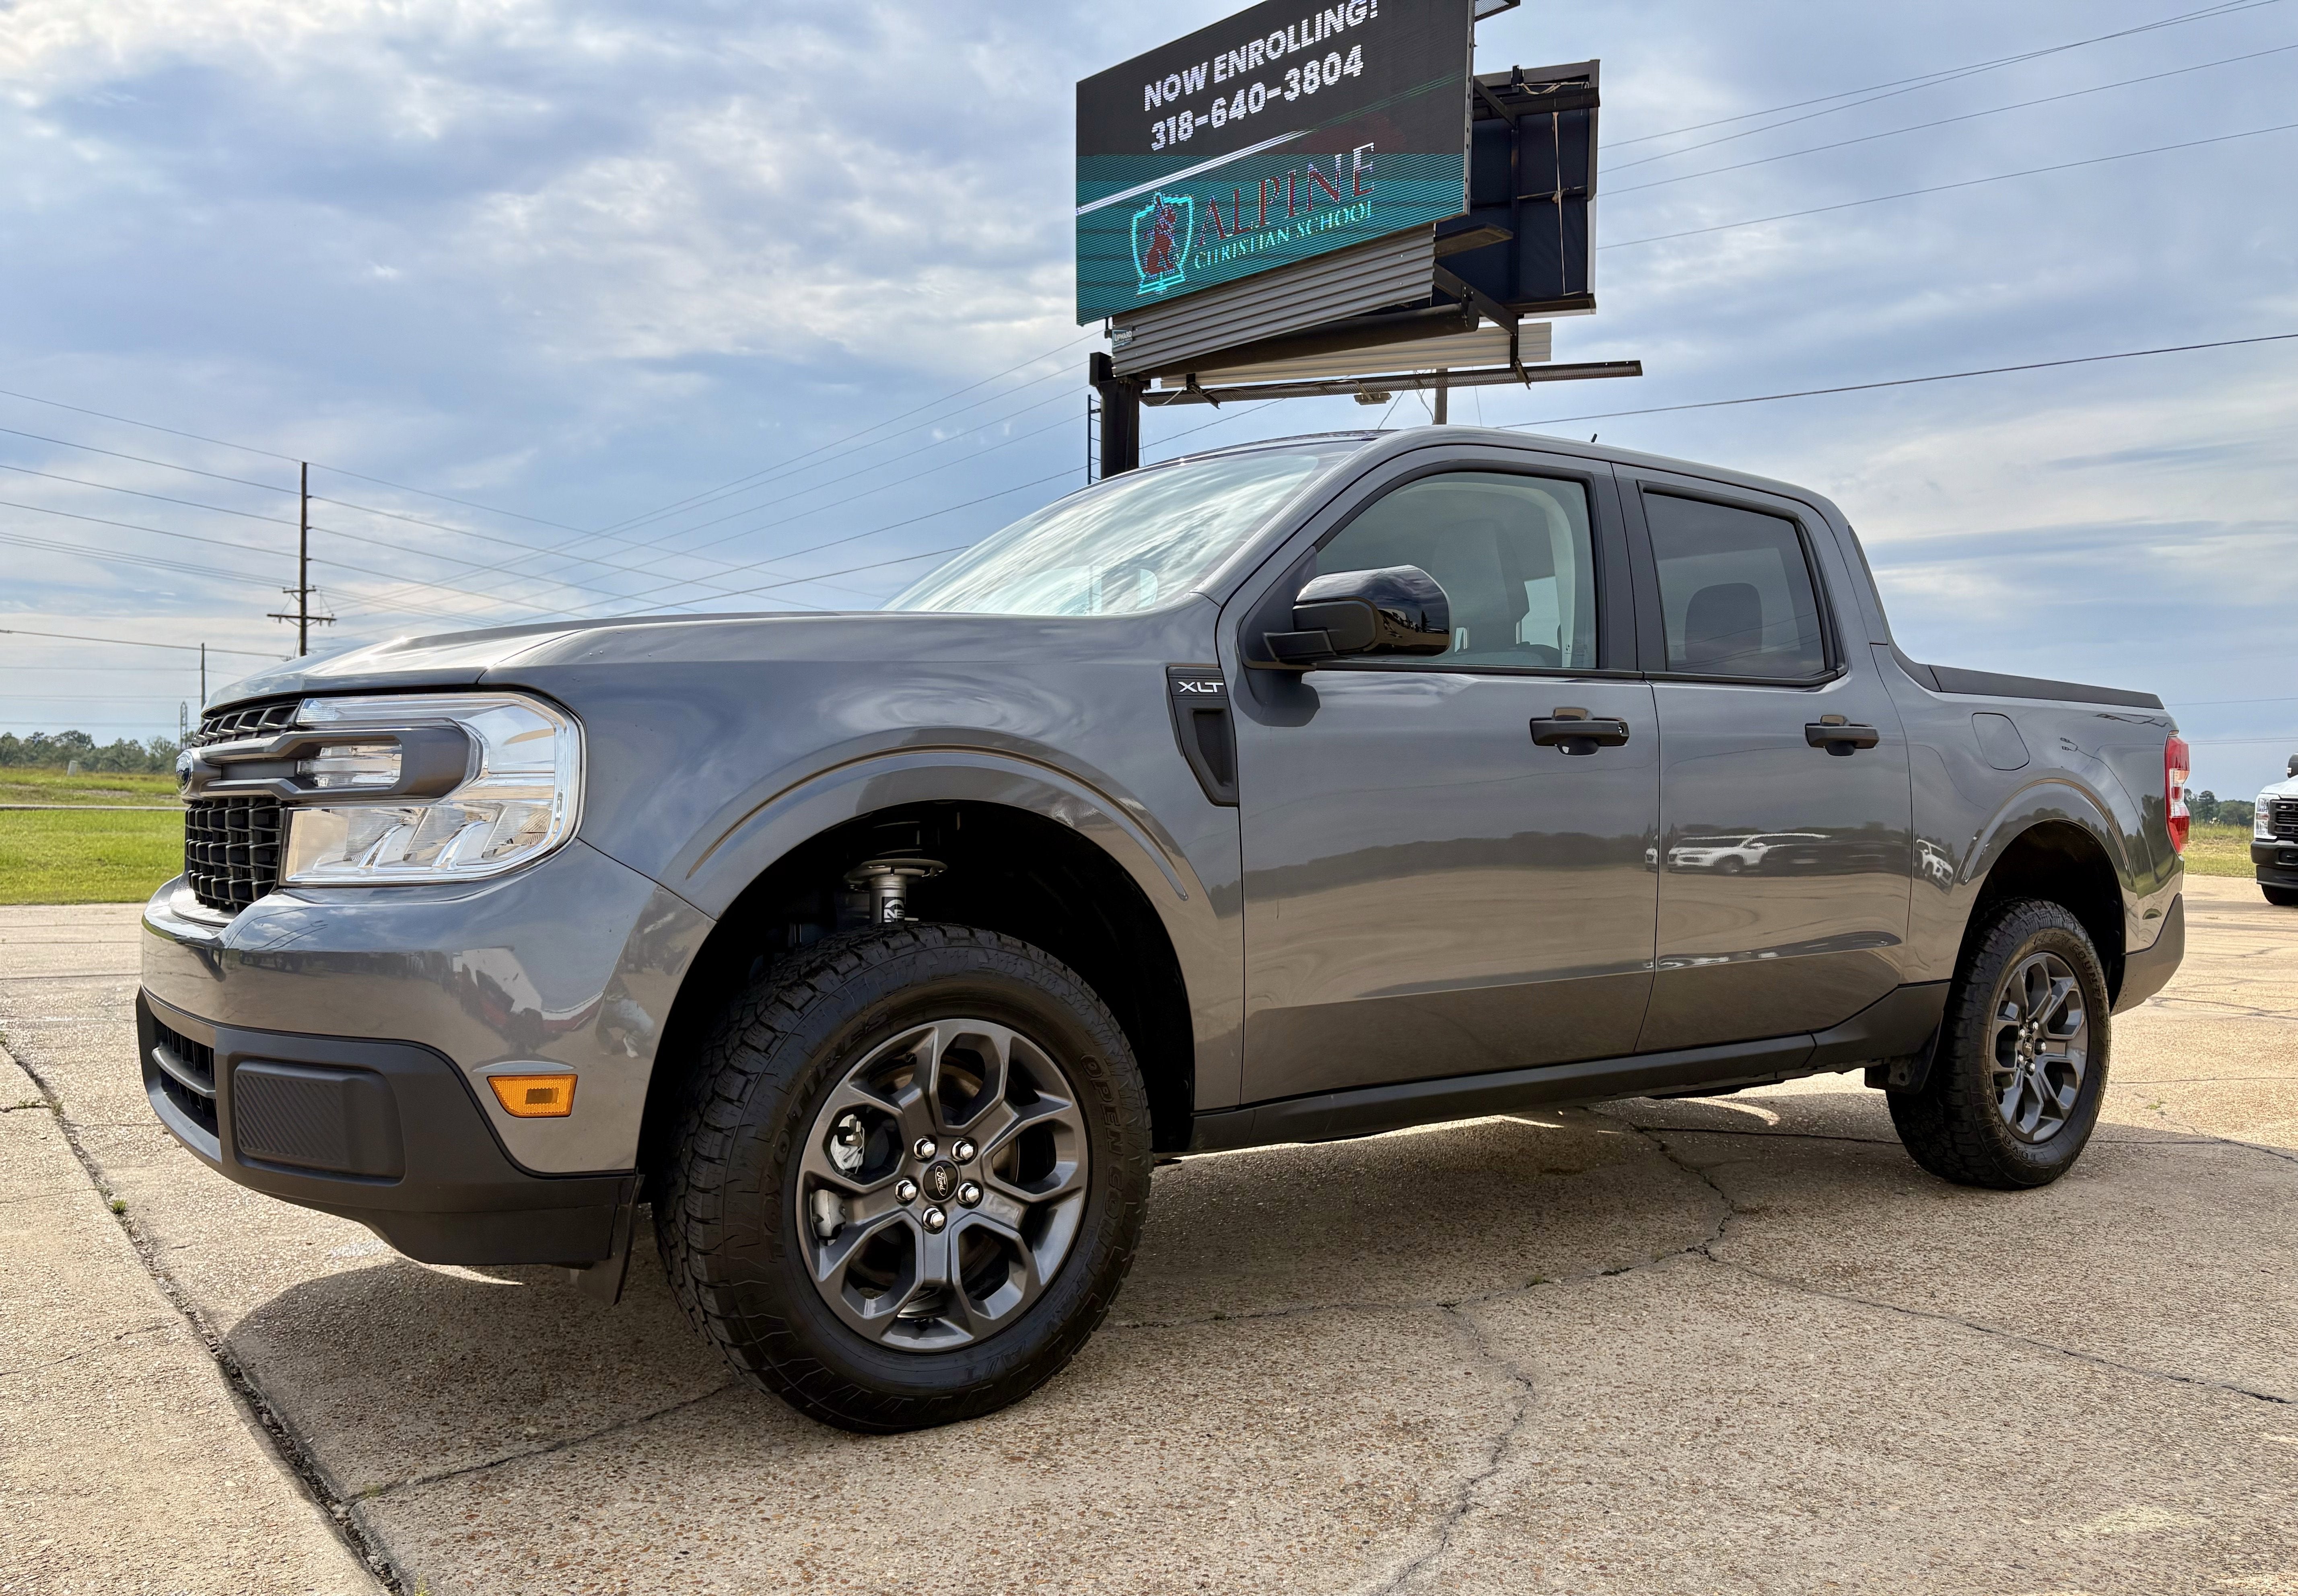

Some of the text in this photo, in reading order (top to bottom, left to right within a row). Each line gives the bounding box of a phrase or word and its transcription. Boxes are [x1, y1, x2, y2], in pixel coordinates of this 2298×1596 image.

[1145, 0, 1378, 111] NOW ENROLLING!
[1151, 45, 1363, 150] 318-640-3804
[1194, 142, 1374, 247] ALPINE
[1194, 200, 1372, 269] CHRISTIAN SCHOOL
[1178, 681, 1224, 693] XLT
[2070, 943, 2106, 1028] COUNTRY
[763, 1002, 890, 1263] TOYO TIRES
[1081, 1053, 1124, 1156] OPEN
[937, 1172, 946, 1191] Ford
[1042, 1164, 1123, 1344] COUNTRY
